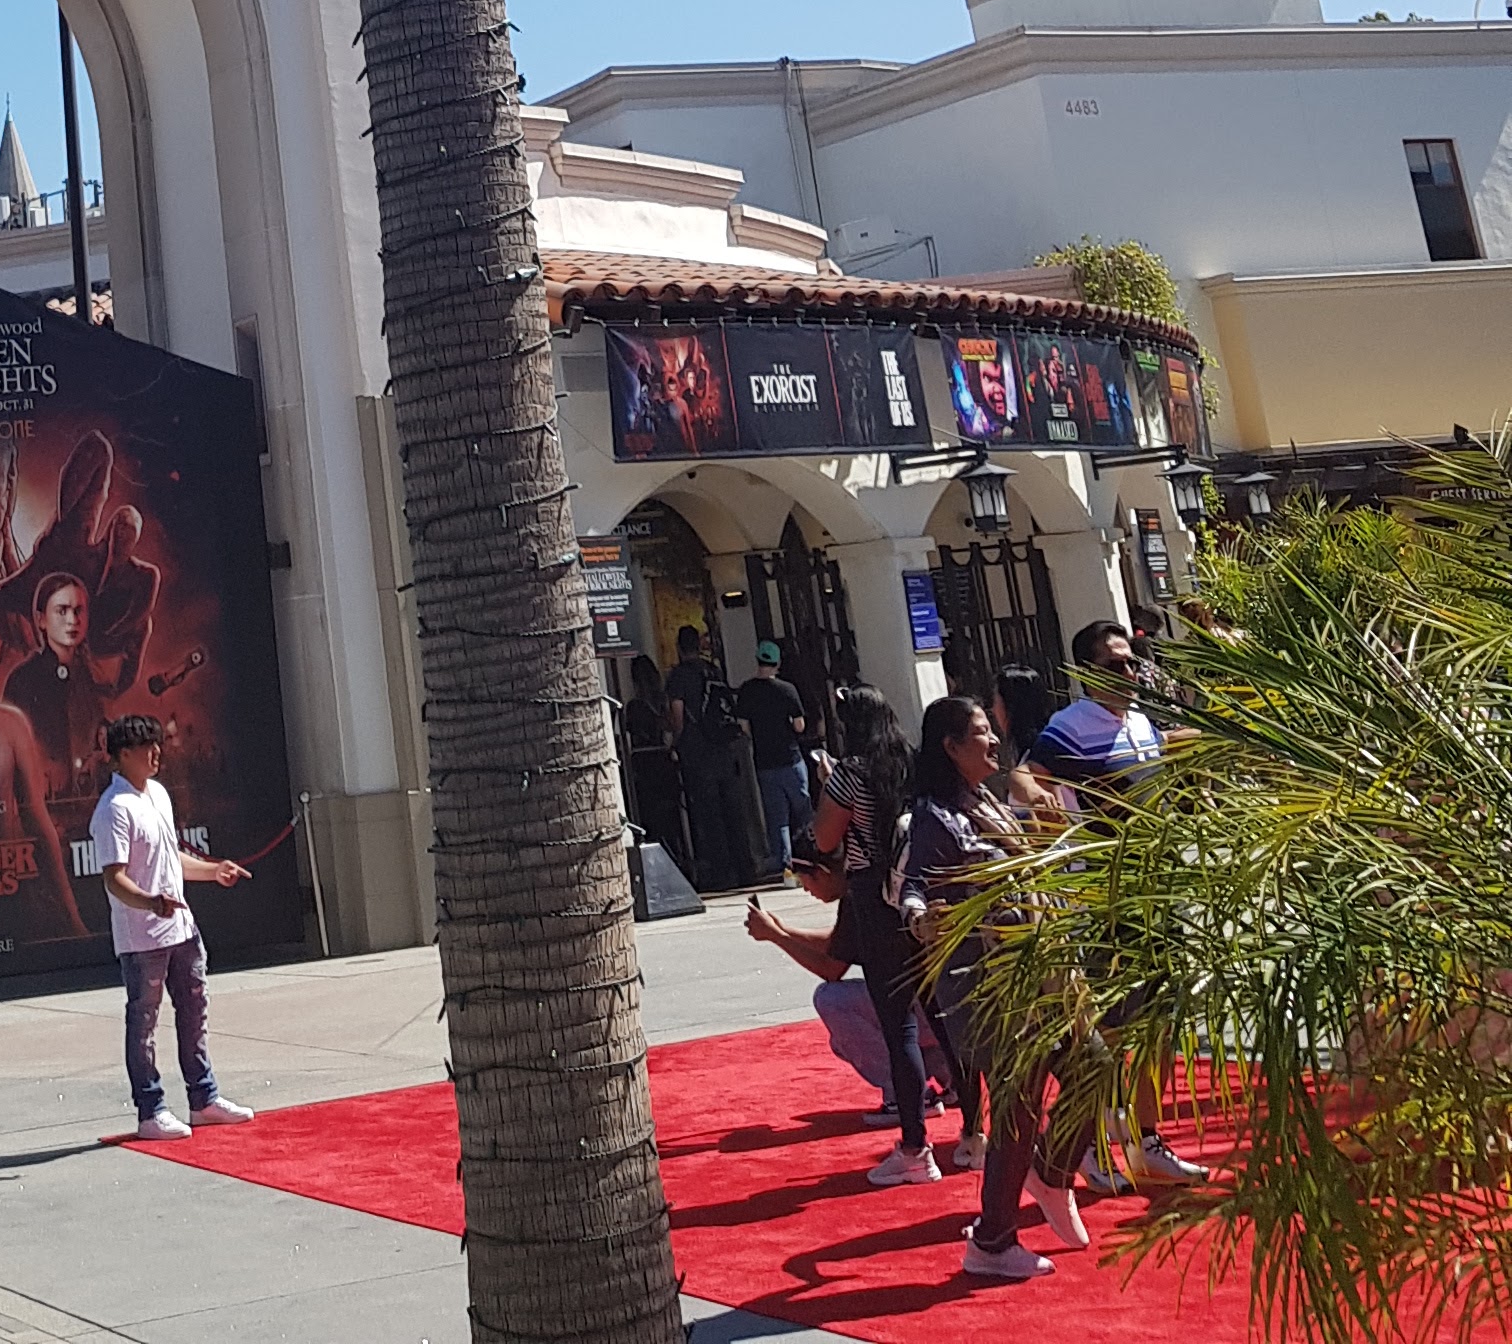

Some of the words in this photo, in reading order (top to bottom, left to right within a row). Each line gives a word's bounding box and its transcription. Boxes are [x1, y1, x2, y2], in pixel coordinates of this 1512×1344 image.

[1065, 99, 1099, 115] 4483
[749, 375, 818, 404] EXORCIST
[885, 375, 909, 401] LAST
[23, 398, 35, 410] 31
